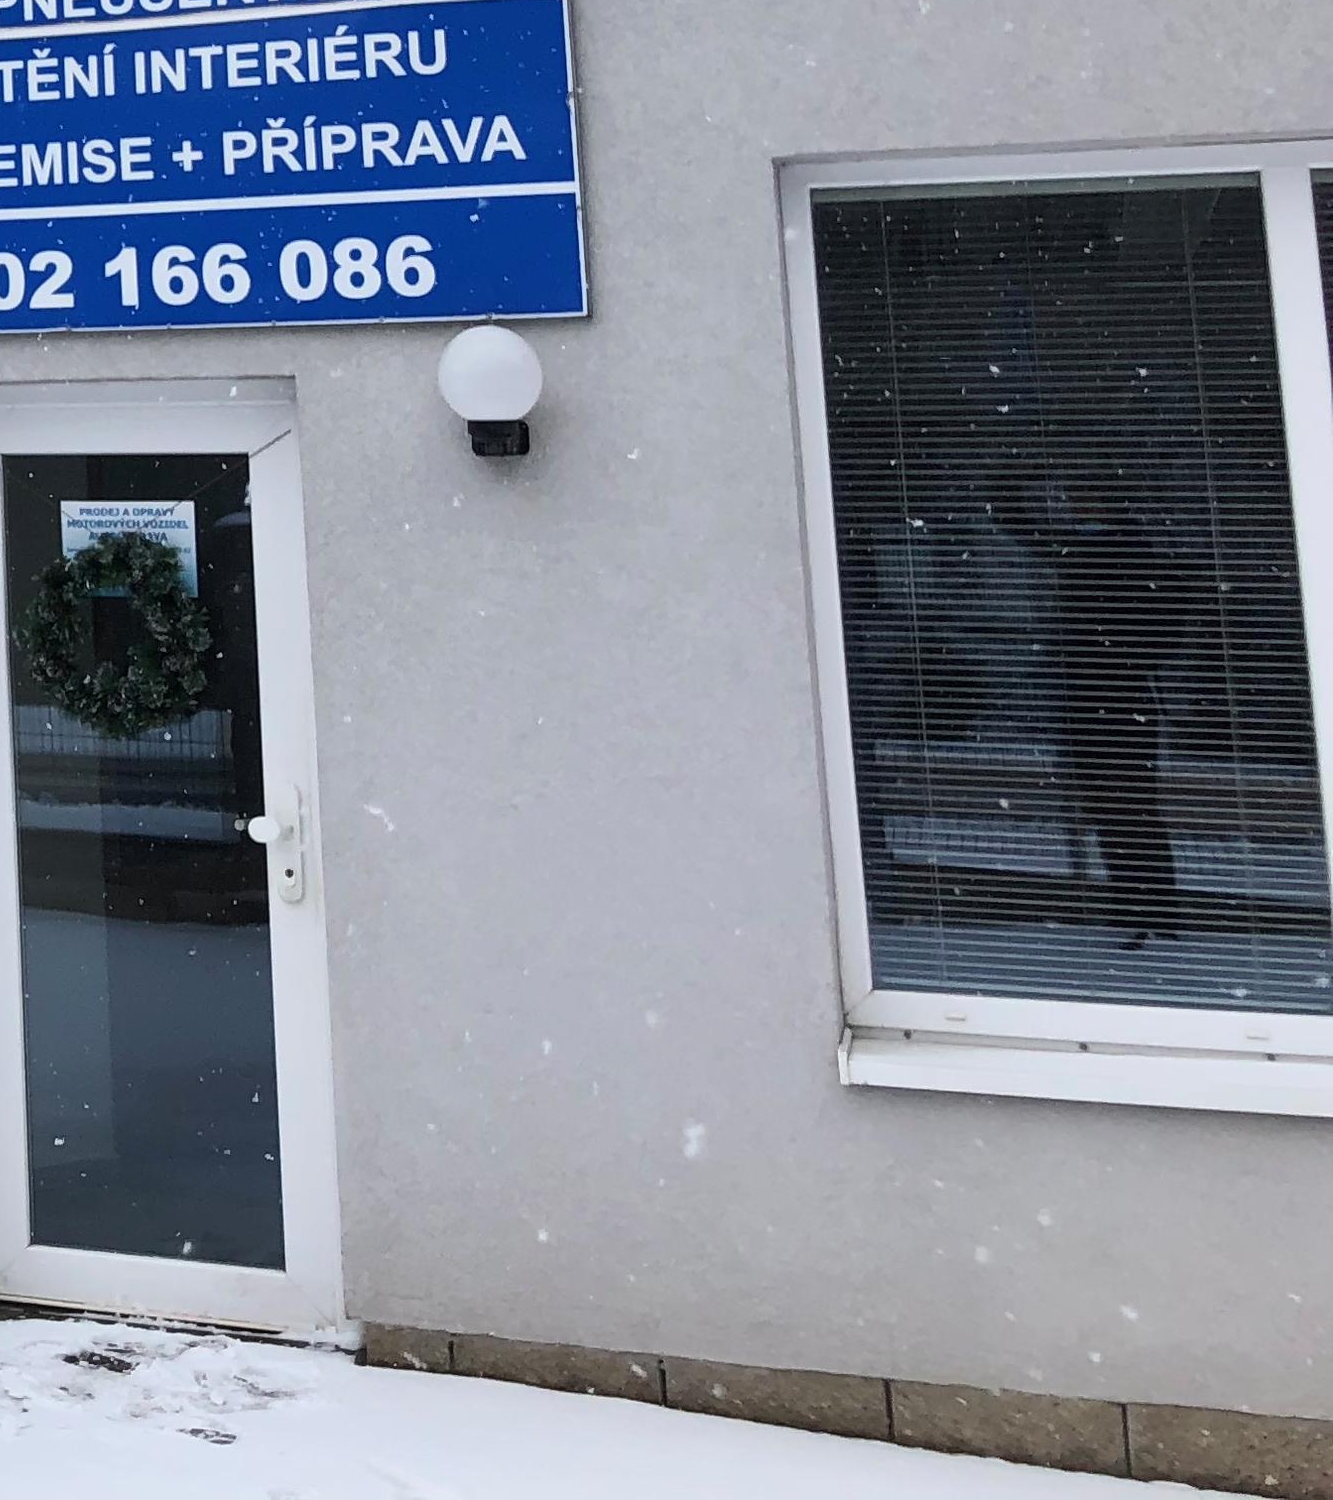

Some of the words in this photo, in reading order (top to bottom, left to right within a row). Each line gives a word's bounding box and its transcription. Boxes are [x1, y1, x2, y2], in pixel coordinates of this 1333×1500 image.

[135, 30, 446, 93] INTERIÉRU
[173, 141, 203, 171] +
[223, 116, 526, 174] PŘÍPRAVA
[105, 244, 250, 309] 166
[280, 236, 435, 303] 086
[79, 507, 120, 517] PRODEJ
[122, 507, 130, 517] A
[132, 507, 175, 517] OPRAVY
